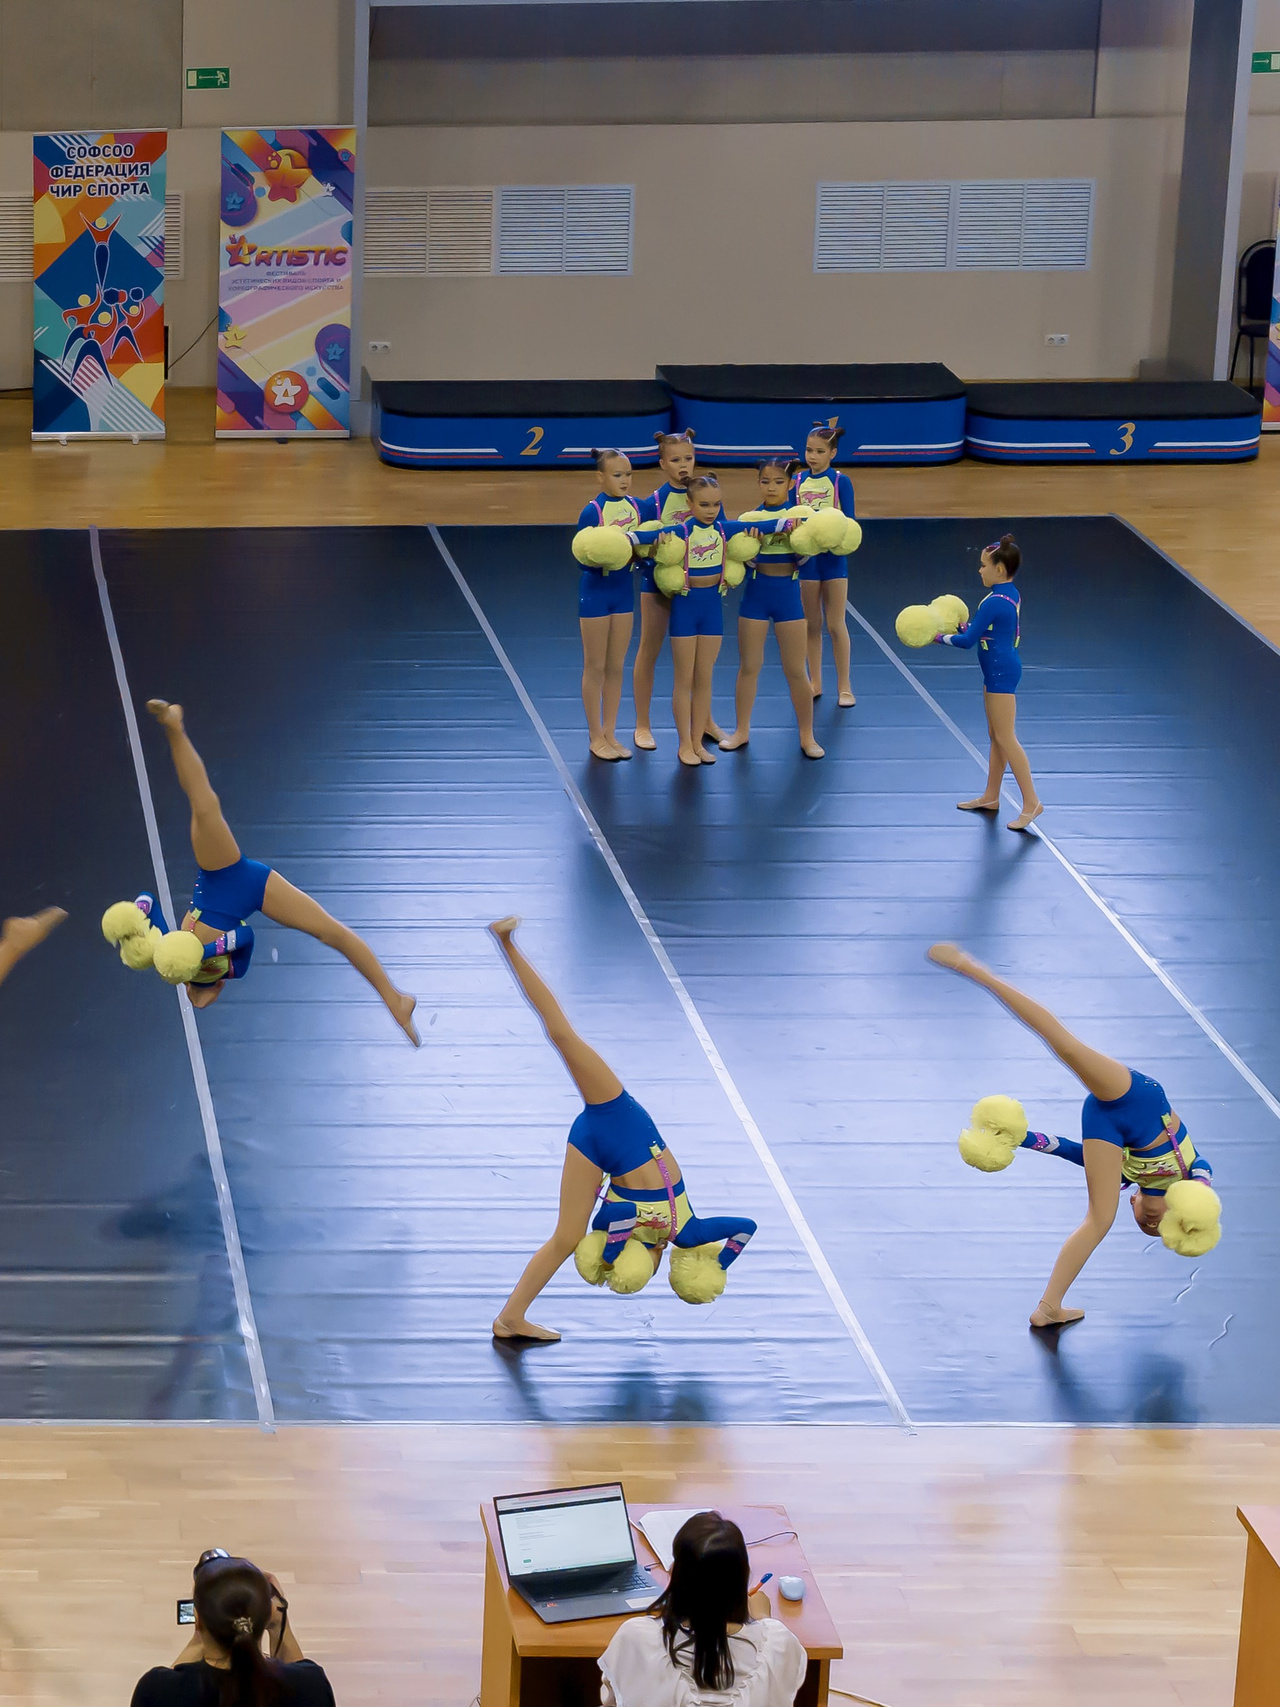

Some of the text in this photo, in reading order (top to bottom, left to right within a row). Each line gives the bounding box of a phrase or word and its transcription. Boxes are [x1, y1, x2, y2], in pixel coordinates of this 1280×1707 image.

[66, 144, 134, 159] СОФСОО
[50, 163, 150, 179] ФЕДЕРАЦИЯ
[49, 182, 150, 198] ЧИР СПОРТА
[519, 426, 544, 455] 2
[1109, 422, 1136, 455] 3
